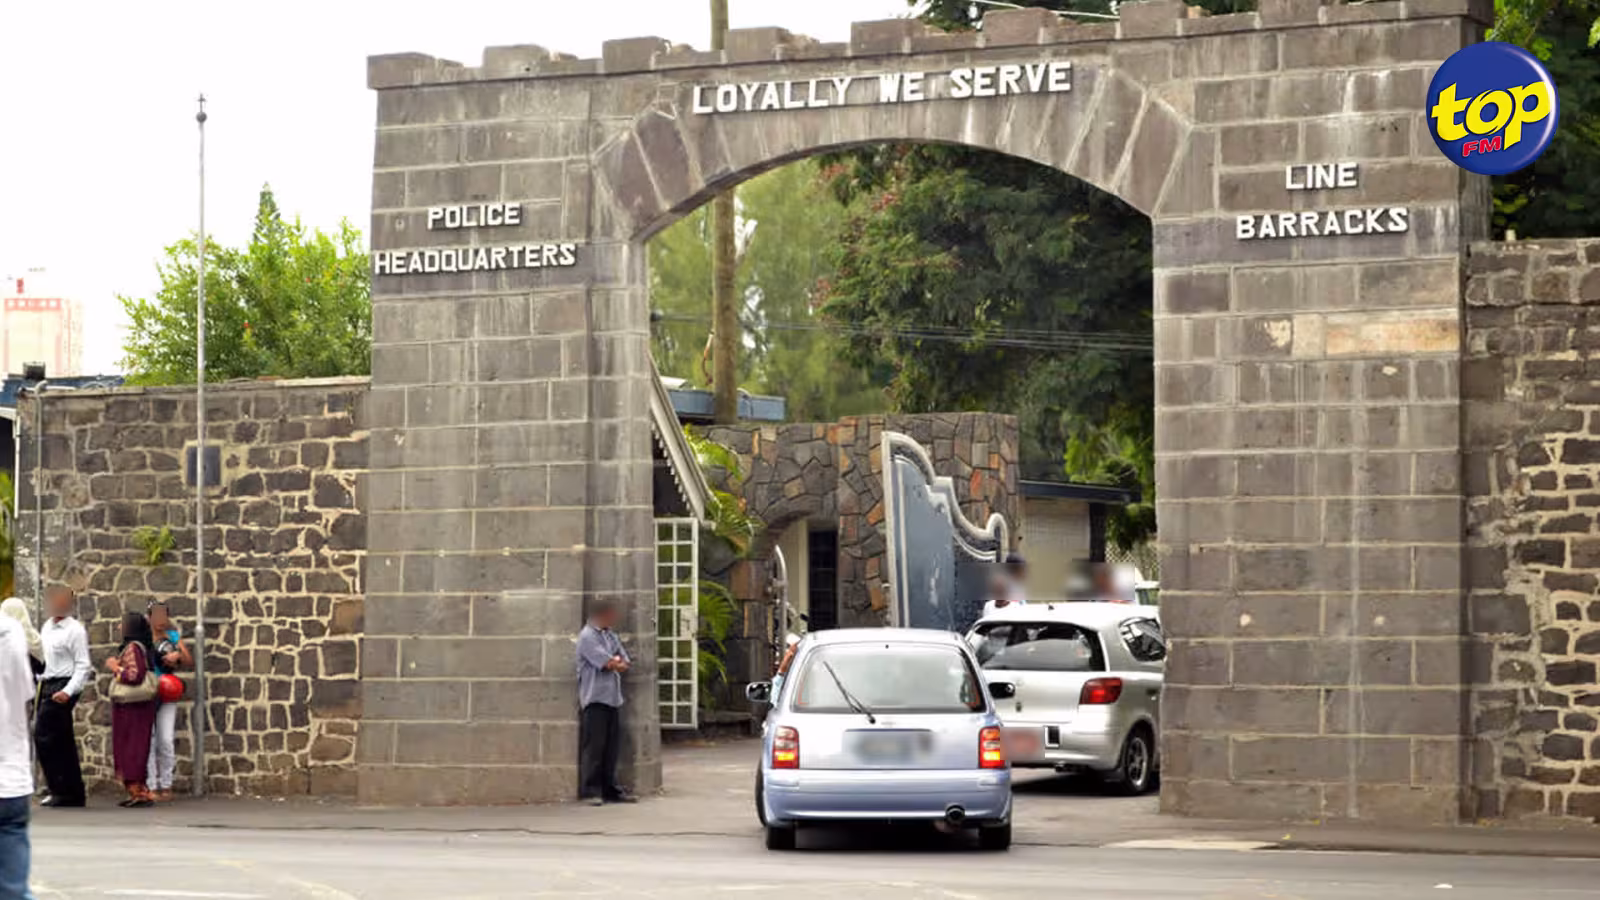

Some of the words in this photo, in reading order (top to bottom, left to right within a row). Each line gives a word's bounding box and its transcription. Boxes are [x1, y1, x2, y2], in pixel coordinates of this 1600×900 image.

[692, 77, 852, 114] LOYALLY
[879, 71, 925, 103] WE
[950, 61, 1072, 98] SERVE
[1285, 162, 1358, 190] LINE
[427, 203, 521, 230] POLICE
[1236, 207, 1408, 239] BARRACKS
[374, 243, 576, 274] HEADQUARTERS
